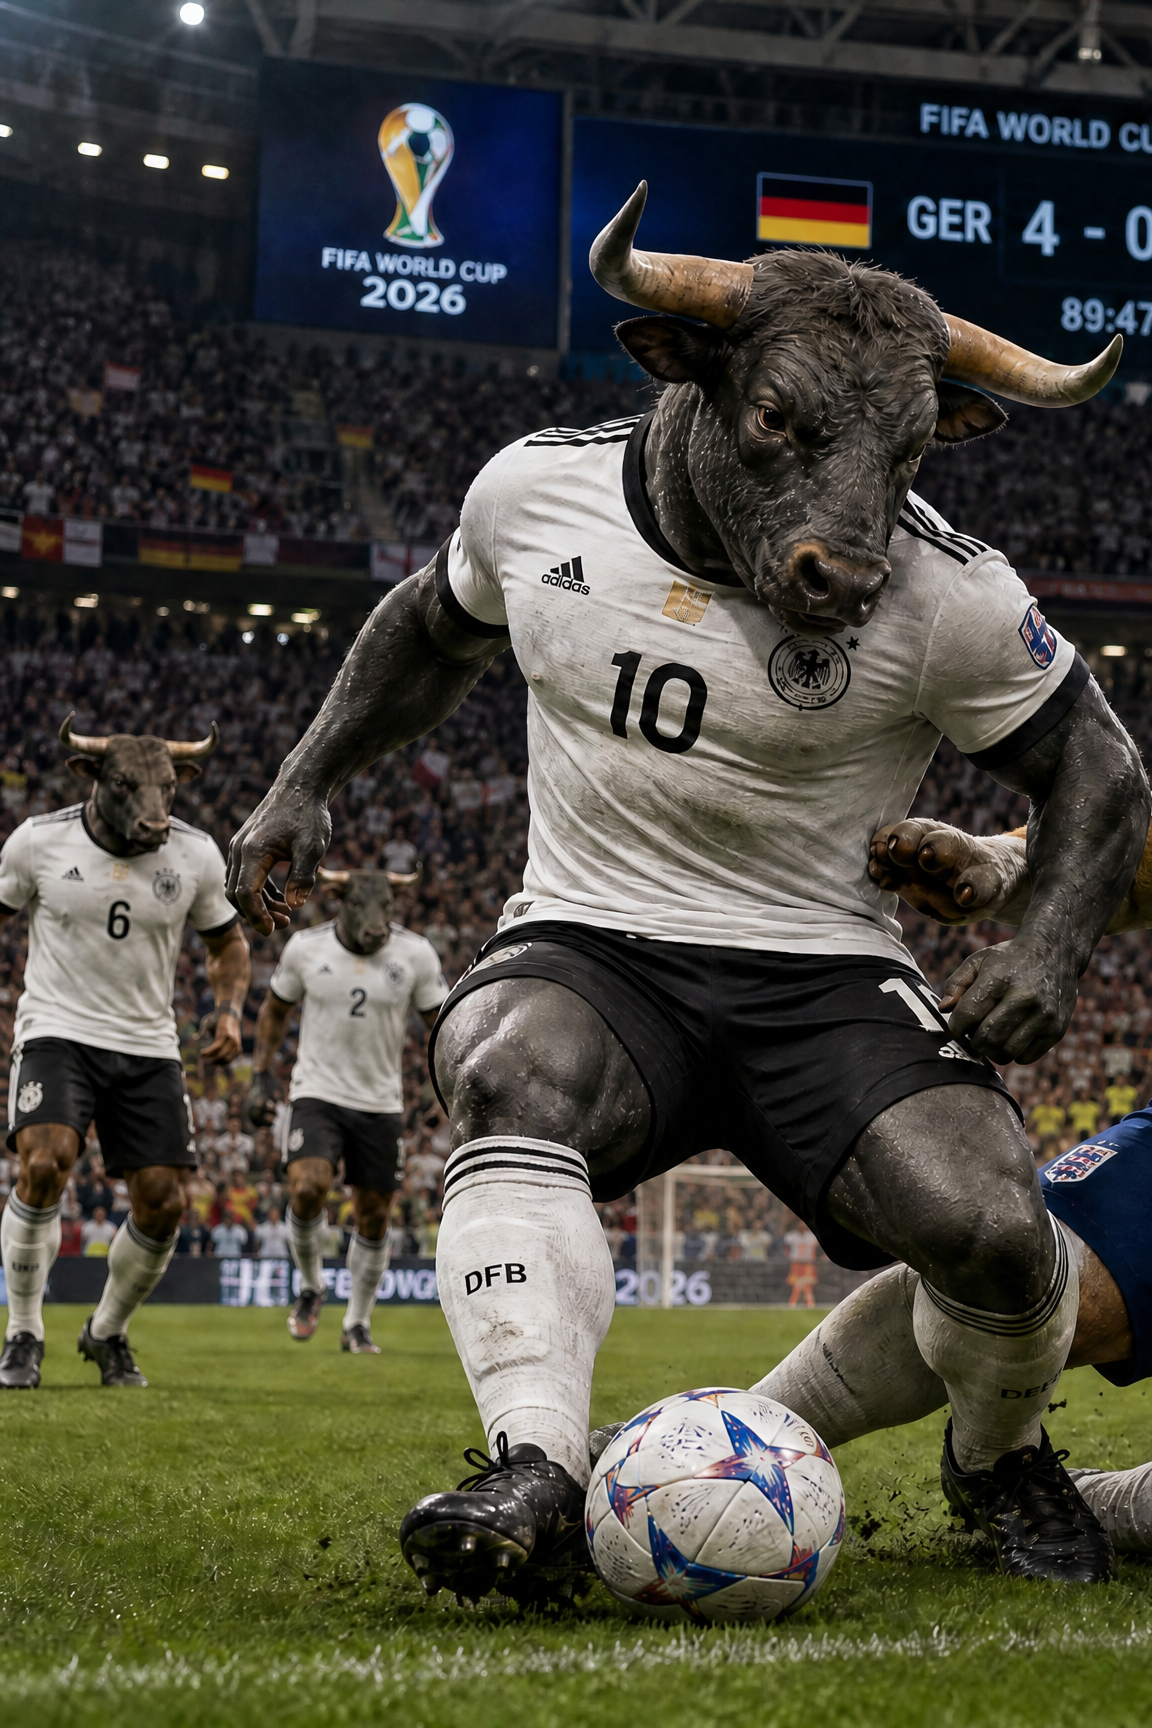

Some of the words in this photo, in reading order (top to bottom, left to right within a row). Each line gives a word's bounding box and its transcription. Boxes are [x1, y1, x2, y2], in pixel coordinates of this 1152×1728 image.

[920, 102, 990, 139] FIFA
[997, 110, 1112, 149] WORLD
[906, 194, 993, 245] GER
[1022, 199, 1060, 257] 4
[322, 247, 373, 273] FIFA
[375, 251, 457, 280] WORLD
[459, 260, 508, 285] CUP
[360, 275, 467, 316] 2026
[541, 573, 591, 596] adidas
[610, 650, 708, 754] 10
[107, 900, 131, 940] 6
[350, 988, 367, 1018] 2
[464, 1262, 527, 1296] DFB
[615, 1268, 703, 1307] 2026
